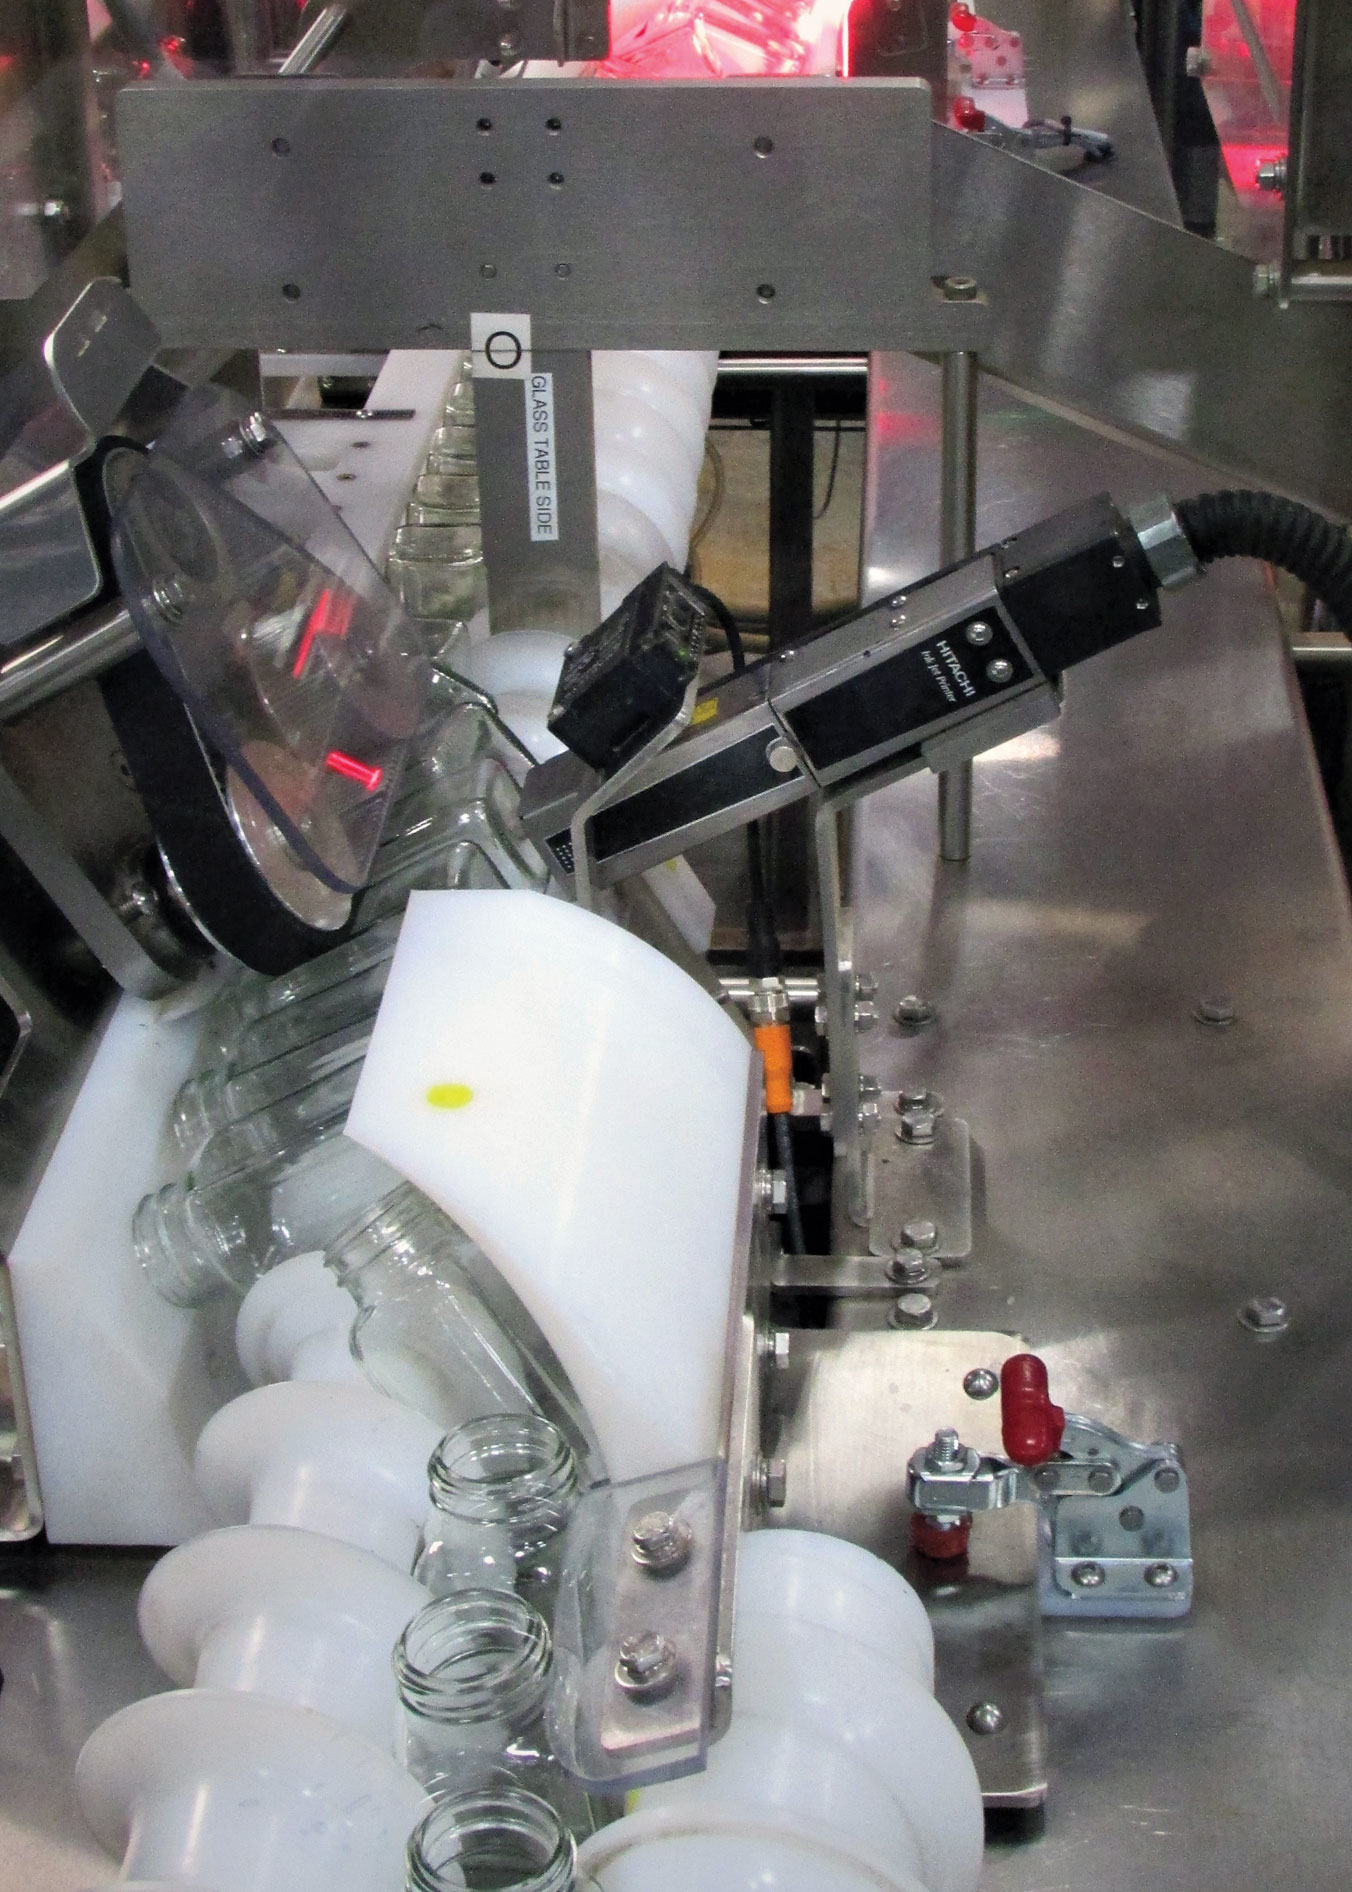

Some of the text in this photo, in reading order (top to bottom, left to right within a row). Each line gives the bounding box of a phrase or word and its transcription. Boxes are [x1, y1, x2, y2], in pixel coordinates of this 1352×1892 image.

[531, 376, 553, 535] GLASS TABLE SIDE
[936, 640, 976, 697] HITACHI
[936, 675, 957, 702] Printer
